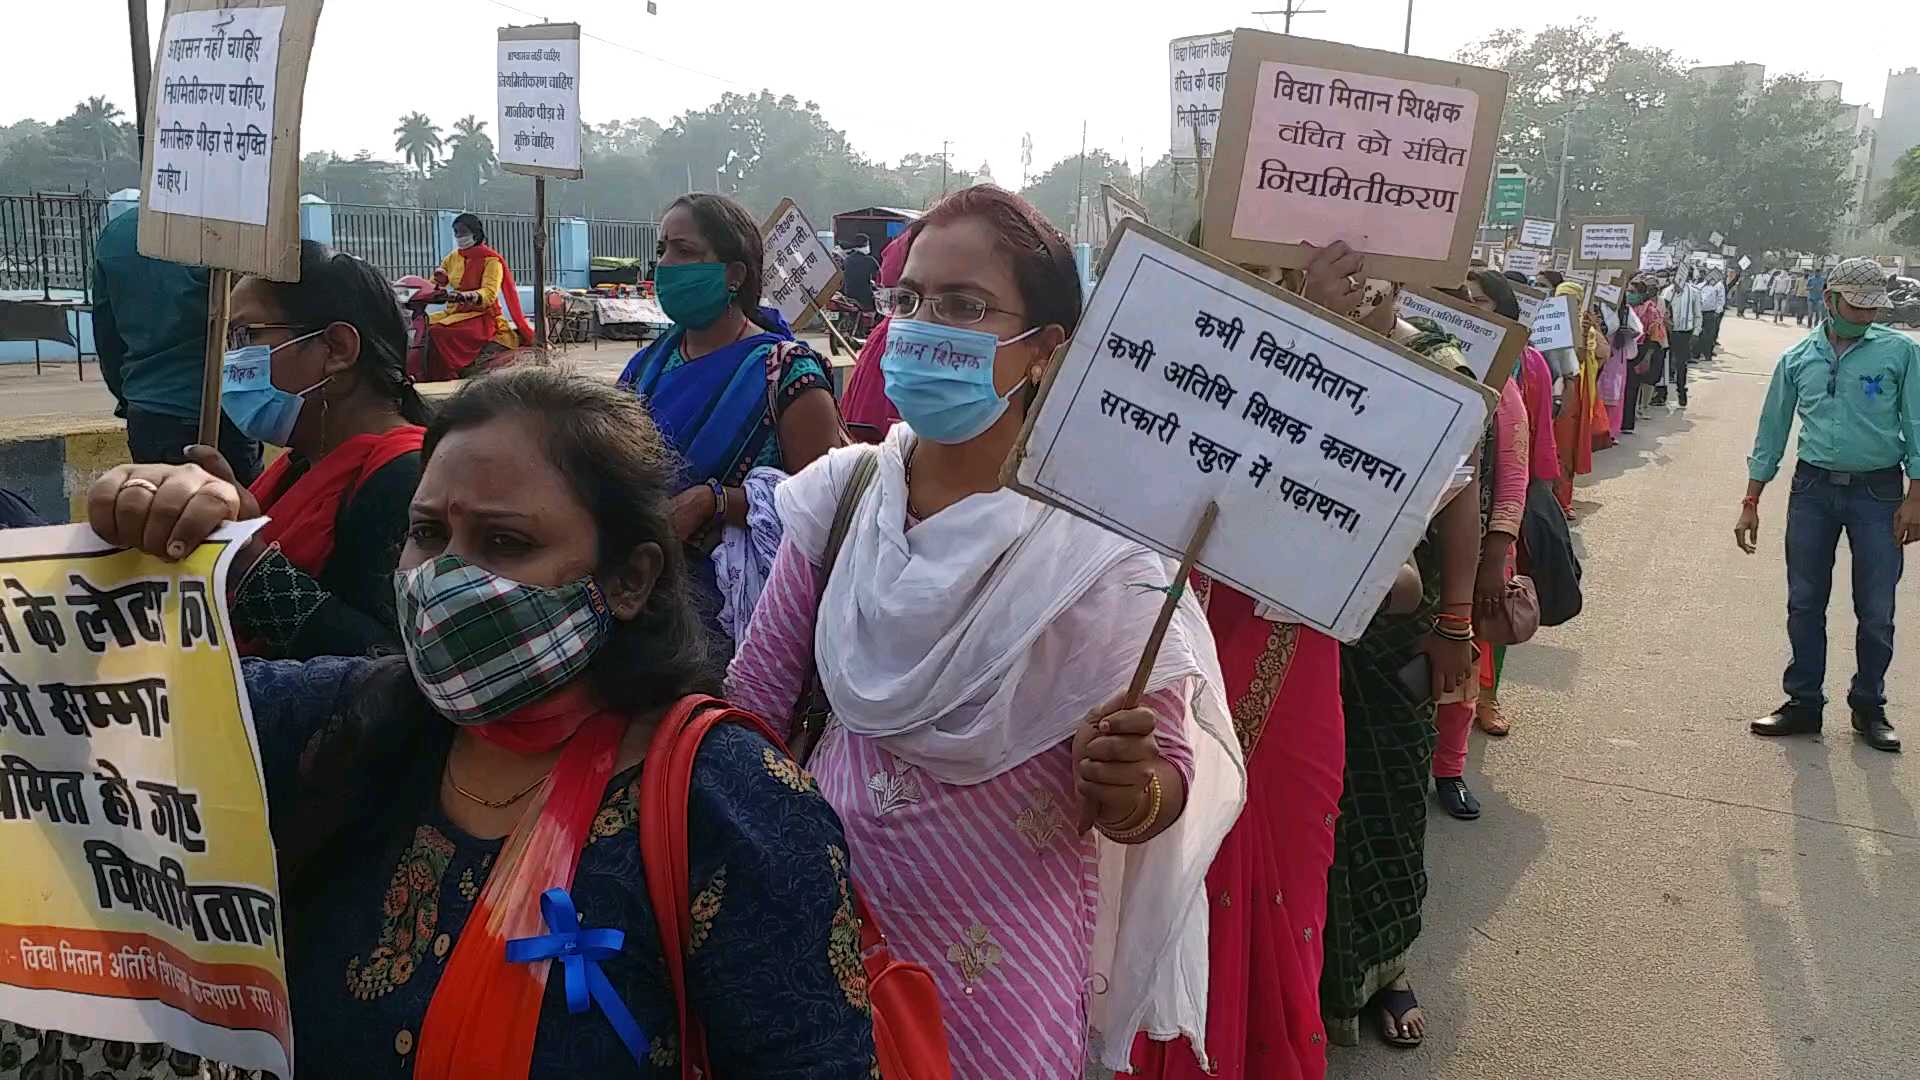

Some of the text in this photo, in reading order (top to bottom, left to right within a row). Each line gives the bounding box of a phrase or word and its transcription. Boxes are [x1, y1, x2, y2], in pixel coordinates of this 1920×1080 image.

[204, 28, 226, 61] नहीं
[227, 29, 262, 62] चाहिए
[163, 75, 226, 105] नियमितीकरण
[498, 72, 573, 89] नियमितीकरण चाहिए
[1194, 67, 1206, 91] की
[1273, 71, 1464, 123] विद्या मितान शिक्षक
[537, 103, 555, 121] पीड़ा
[557, 104, 566, 120] से
[196, 122, 221, 156] पीड़ा
[223, 122, 234, 153] से
[236, 124, 267, 161] मुक्ति
[1278, 120, 1467, 167] वंचित को संचित
[1256, 158, 1459, 213] नियमितीकरण
[1195, 310, 1368, 416] कभी विद्यामितान,
[1107, 331, 1156, 372] कभी
[1163, 361, 1238, 410] अतिथि
[1241, 391, 1313, 444] शिक्षक
[1100, 389, 1181, 445] सरकारी
[1248, 454, 1273, 488] में
[3, 578, 67, 653] के
[20, 938, 57, 971] विद्या
[60, 940, 104, 977] मितान
[109, 945, 158, 980] अतिथि
